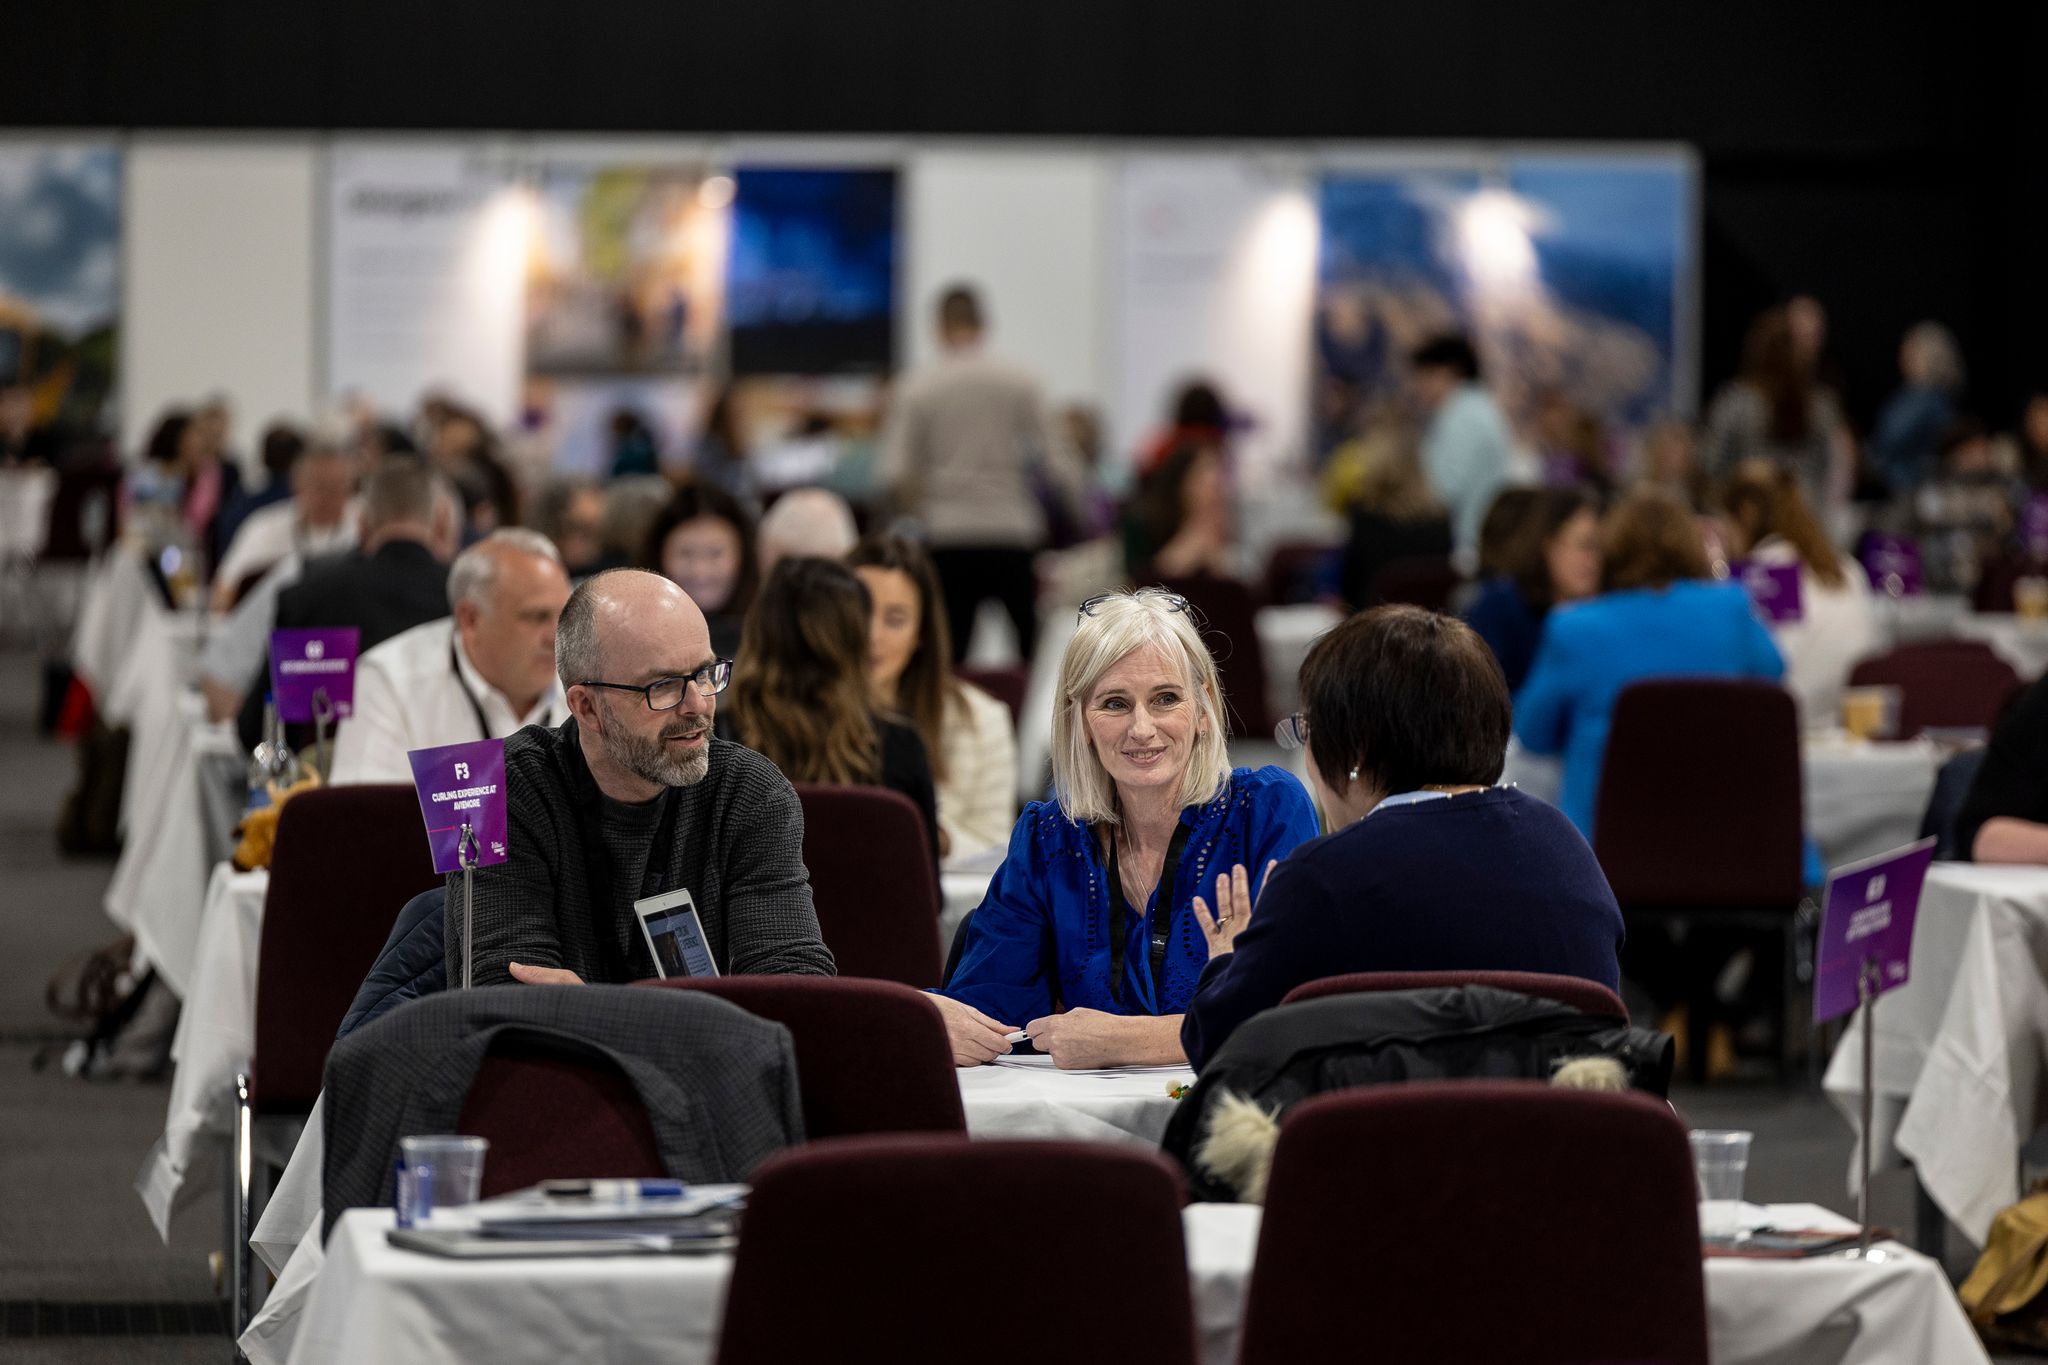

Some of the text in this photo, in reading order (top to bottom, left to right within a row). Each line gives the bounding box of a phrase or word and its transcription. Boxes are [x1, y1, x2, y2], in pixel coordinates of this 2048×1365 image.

[454, 762, 470, 780] F3
[432, 785, 496, 802] CURLING EXPERIENCE AT
